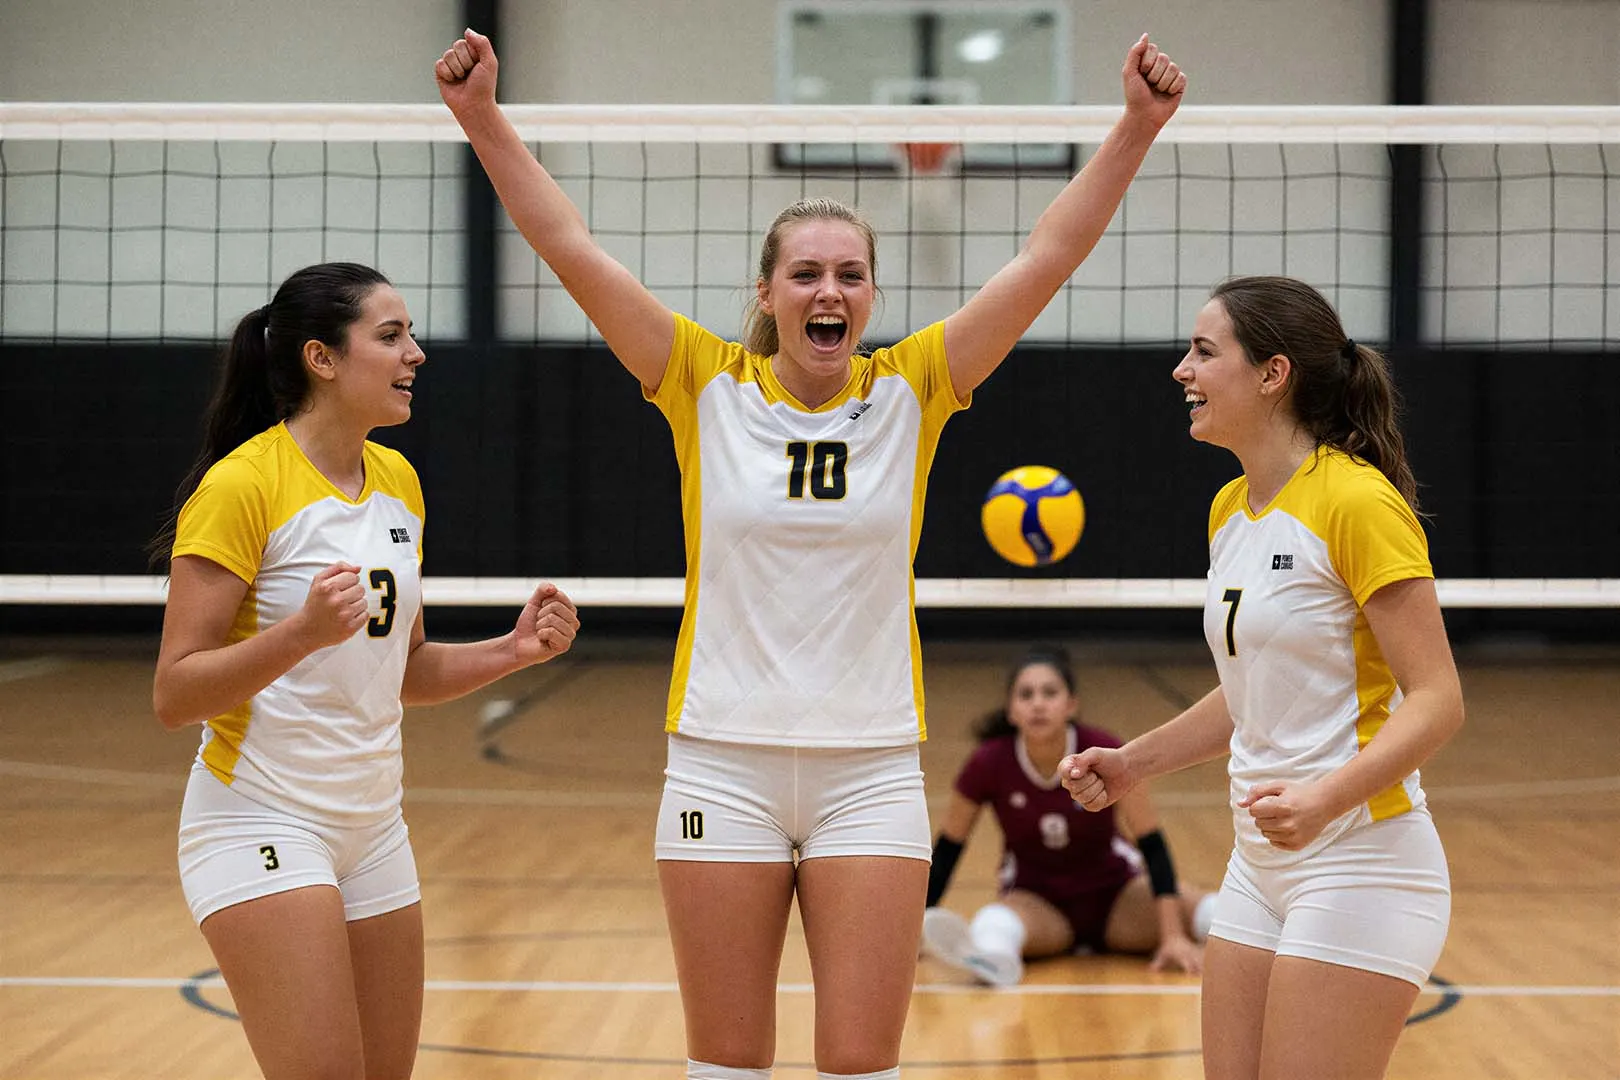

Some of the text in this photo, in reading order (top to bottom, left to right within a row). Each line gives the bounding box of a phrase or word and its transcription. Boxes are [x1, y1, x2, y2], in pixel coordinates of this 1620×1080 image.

[785, 440, 848, 501] 10
[367, 567, 397, 638] 3
[1222, 587, 1243, 657] 7
[679, 809, 704, 840] 10
[259, 845, 280, 872] 3
